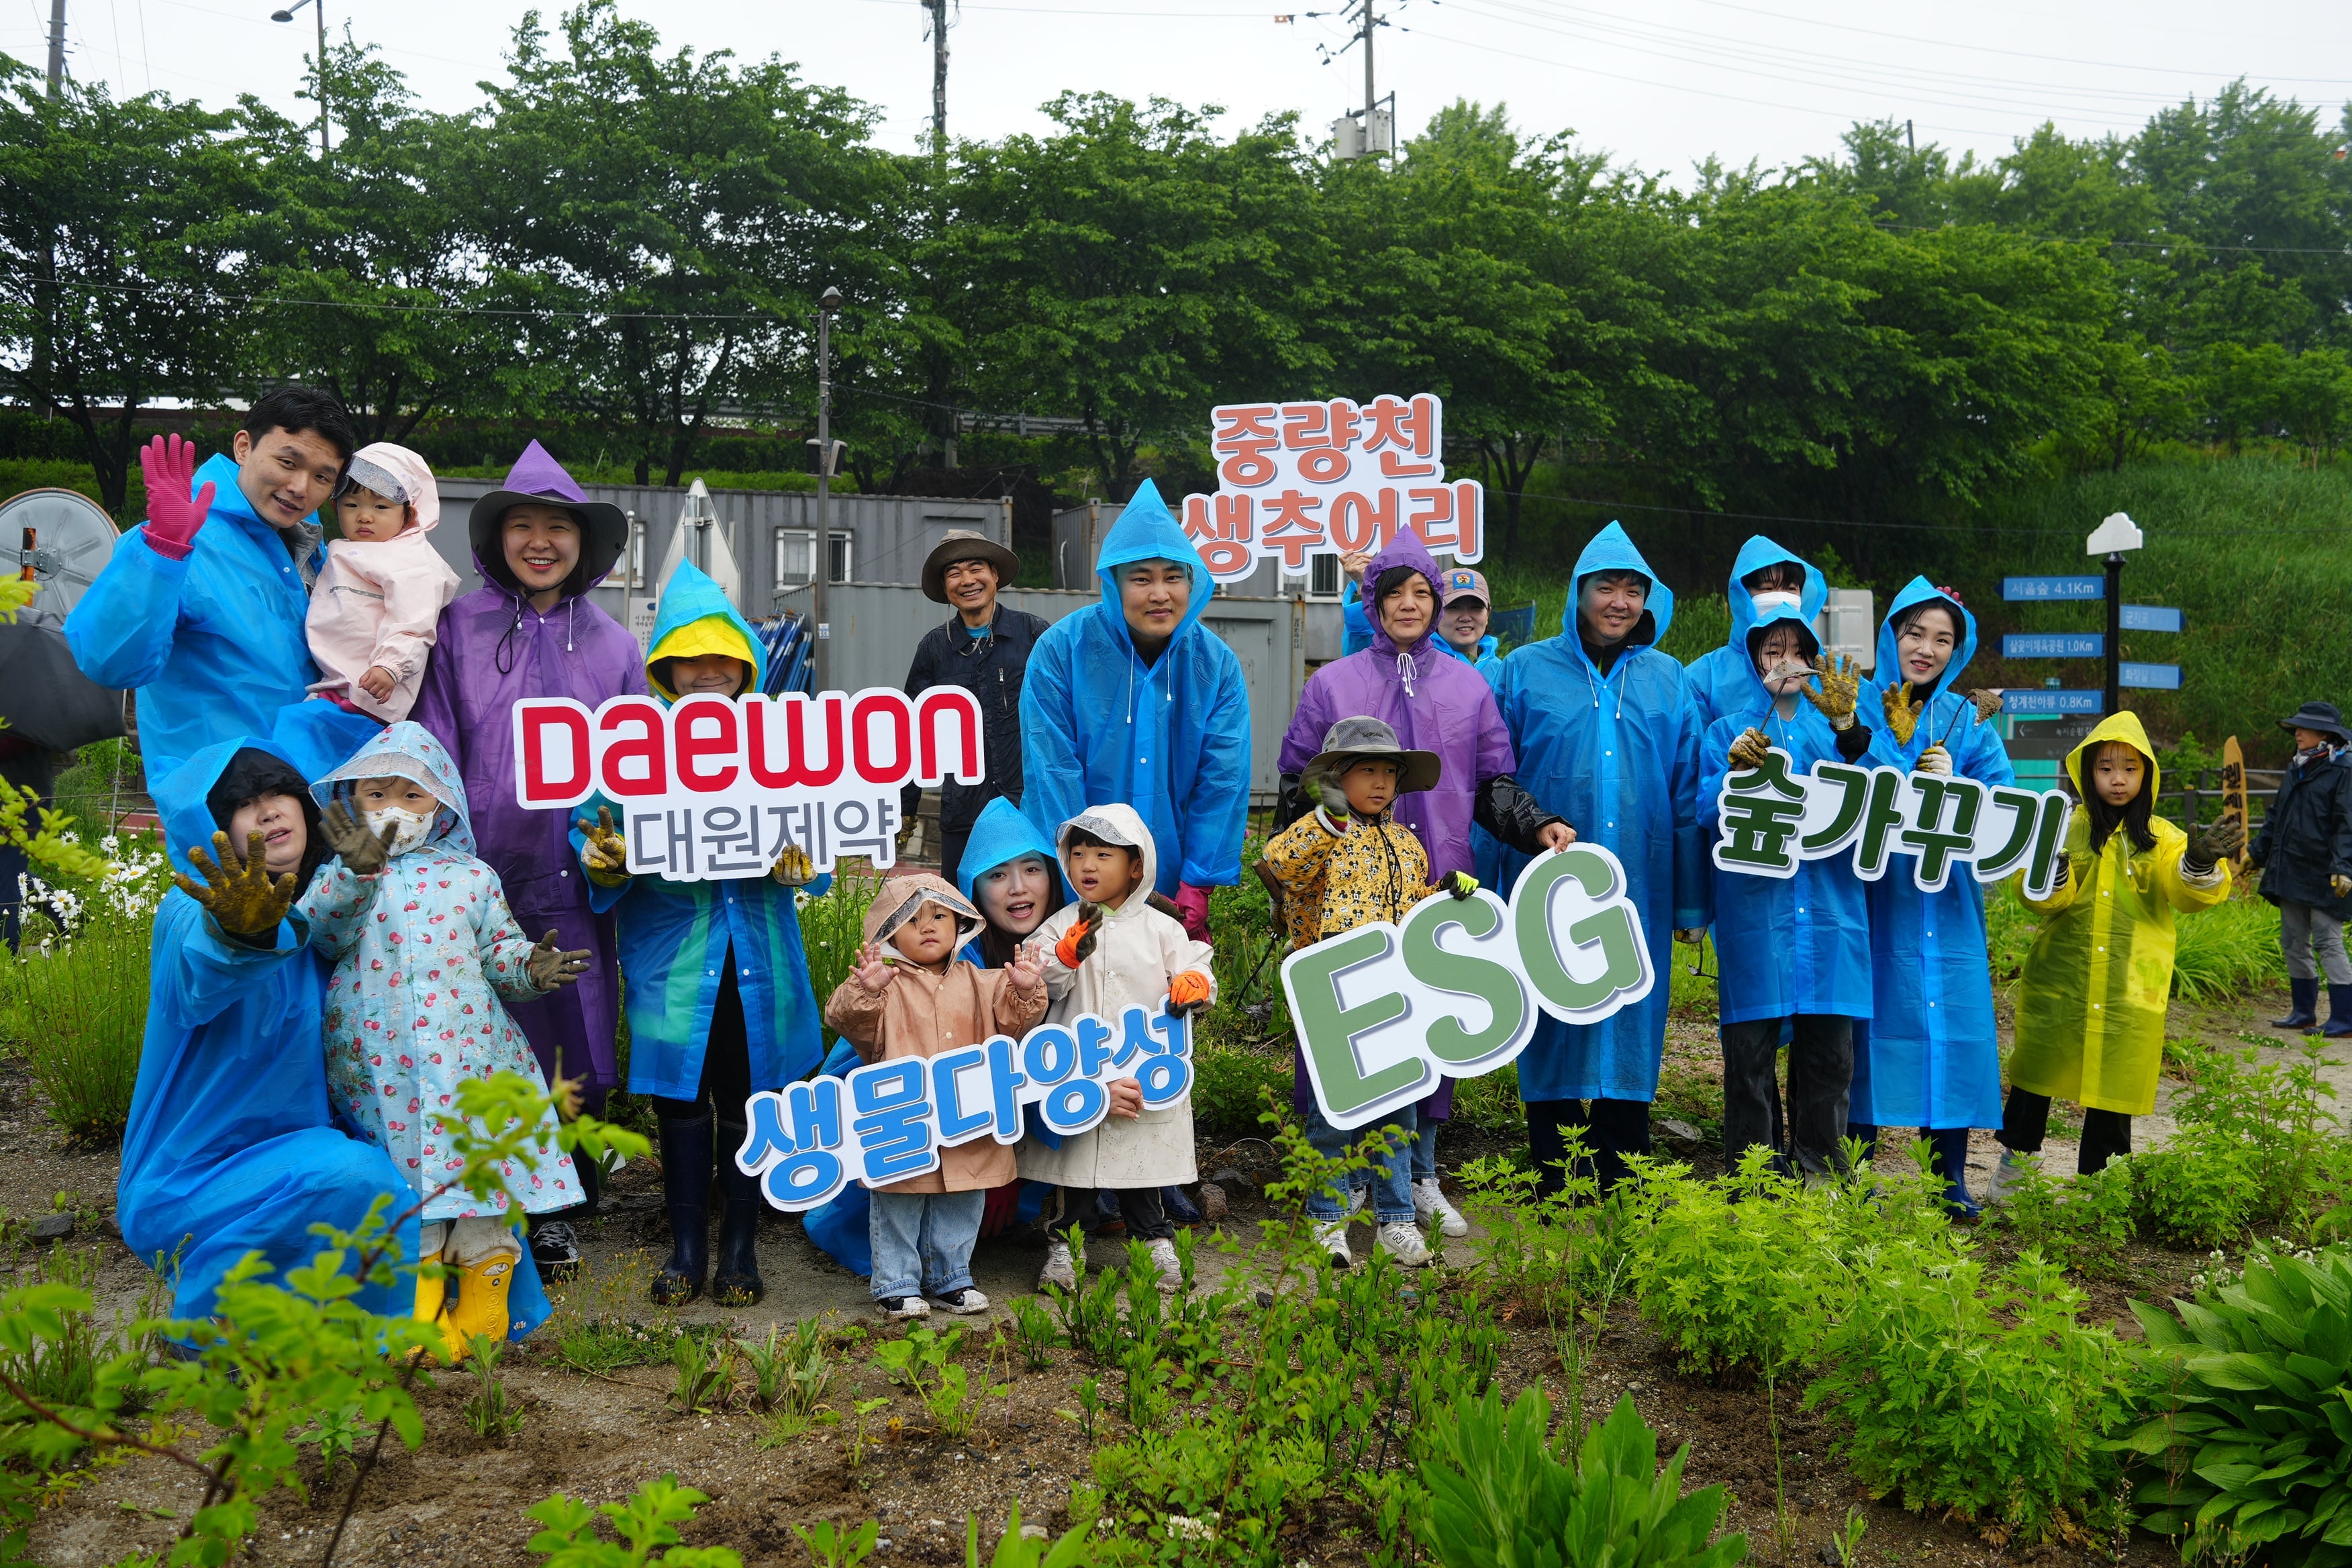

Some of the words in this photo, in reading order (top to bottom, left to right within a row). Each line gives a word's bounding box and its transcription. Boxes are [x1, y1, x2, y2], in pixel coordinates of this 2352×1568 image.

[1216, 397, 1434, 487] 중량천
[1183, 483, 1477, 575] 생추어리
[2054, 581, 2094, 595] 4.1Km
[2067, 639, 2094, 652] 1.0Km
[521, 692, 978, 802] Daewon
[2008, 695, 2055, 710] 청계천하류
[2059, 695, 2093, 709] 0.8Km
[632, 797, 895, 874] 대원제약
[1718, 752, 2065, 891] 숲가꾸기
[1289, 849, 1643, 1116] ESG
[742, 1000, 1188, 1203] 생물다양성
[1392, 1232, 1405, 1244] N
